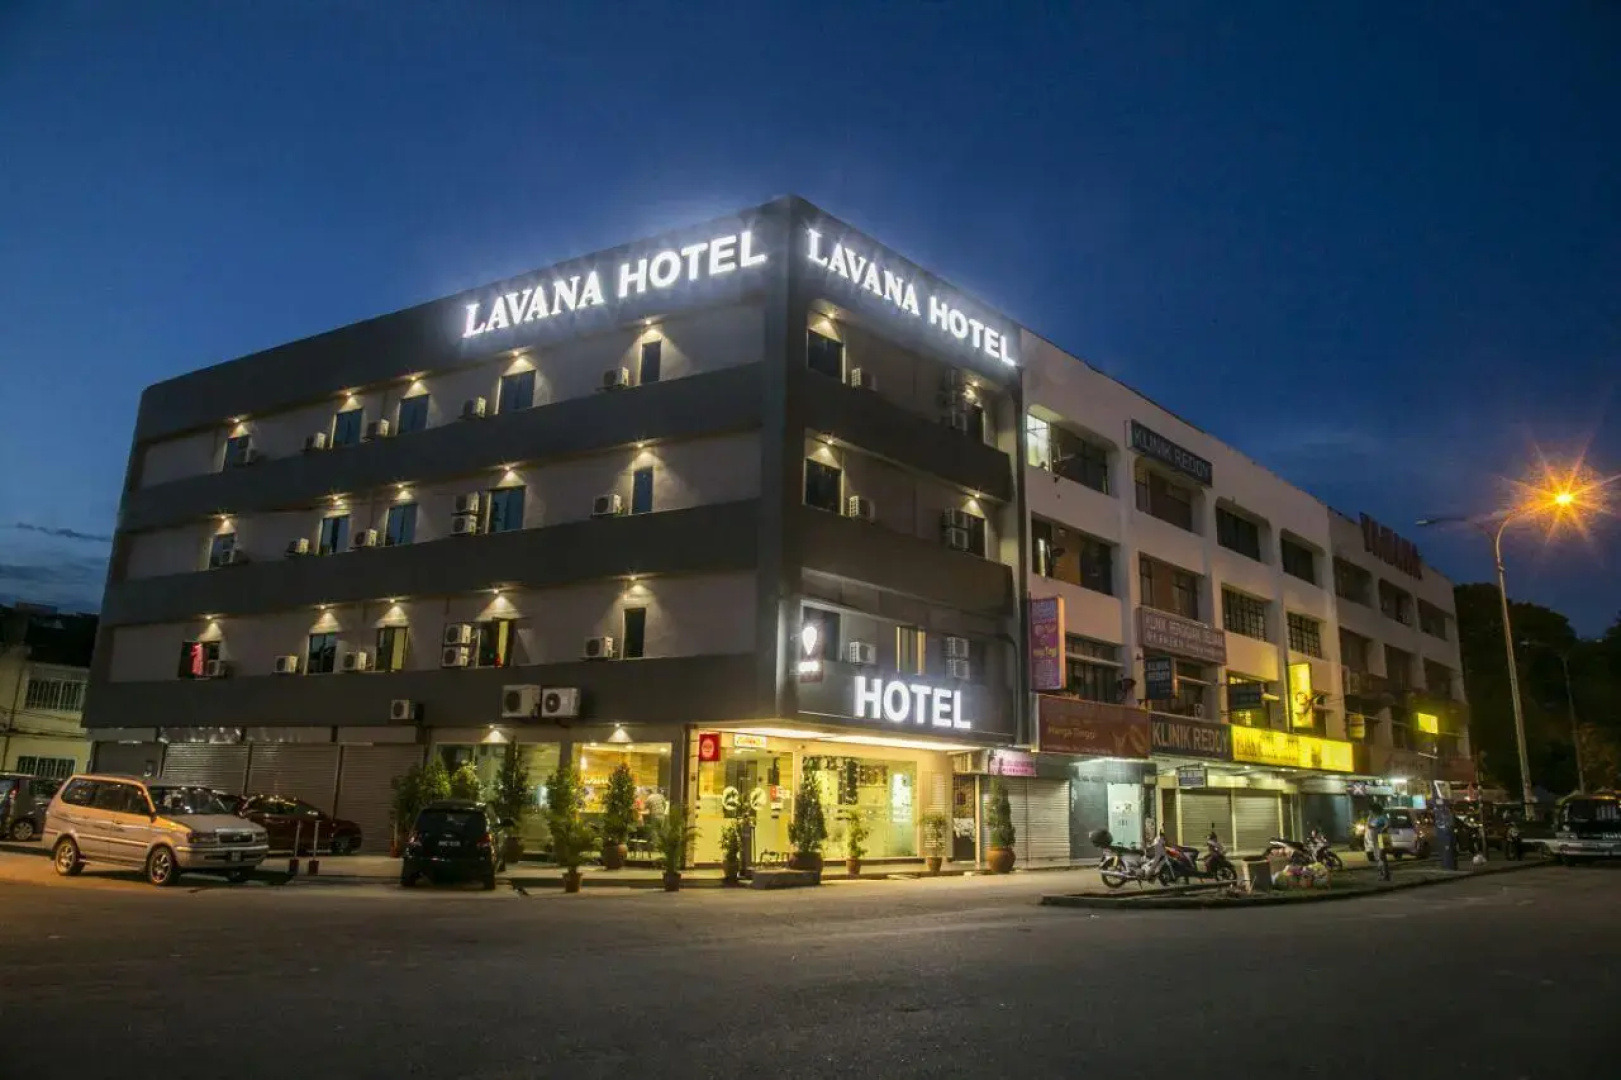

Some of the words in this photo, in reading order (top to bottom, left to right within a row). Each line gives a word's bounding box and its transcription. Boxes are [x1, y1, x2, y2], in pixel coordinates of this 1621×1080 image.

[462, 270, 604, 338] LAVANA
[617, 229, 768, 299] HOTEL
[807, 228, 920, 316] LAVANA
[929, 295, 1017, 367] HOTEL
[854, 675, 972, 729] HOTEL
[1151, 721, 1190, 749] KLINIK
[1193, 727, 1228, 754] REDDY
